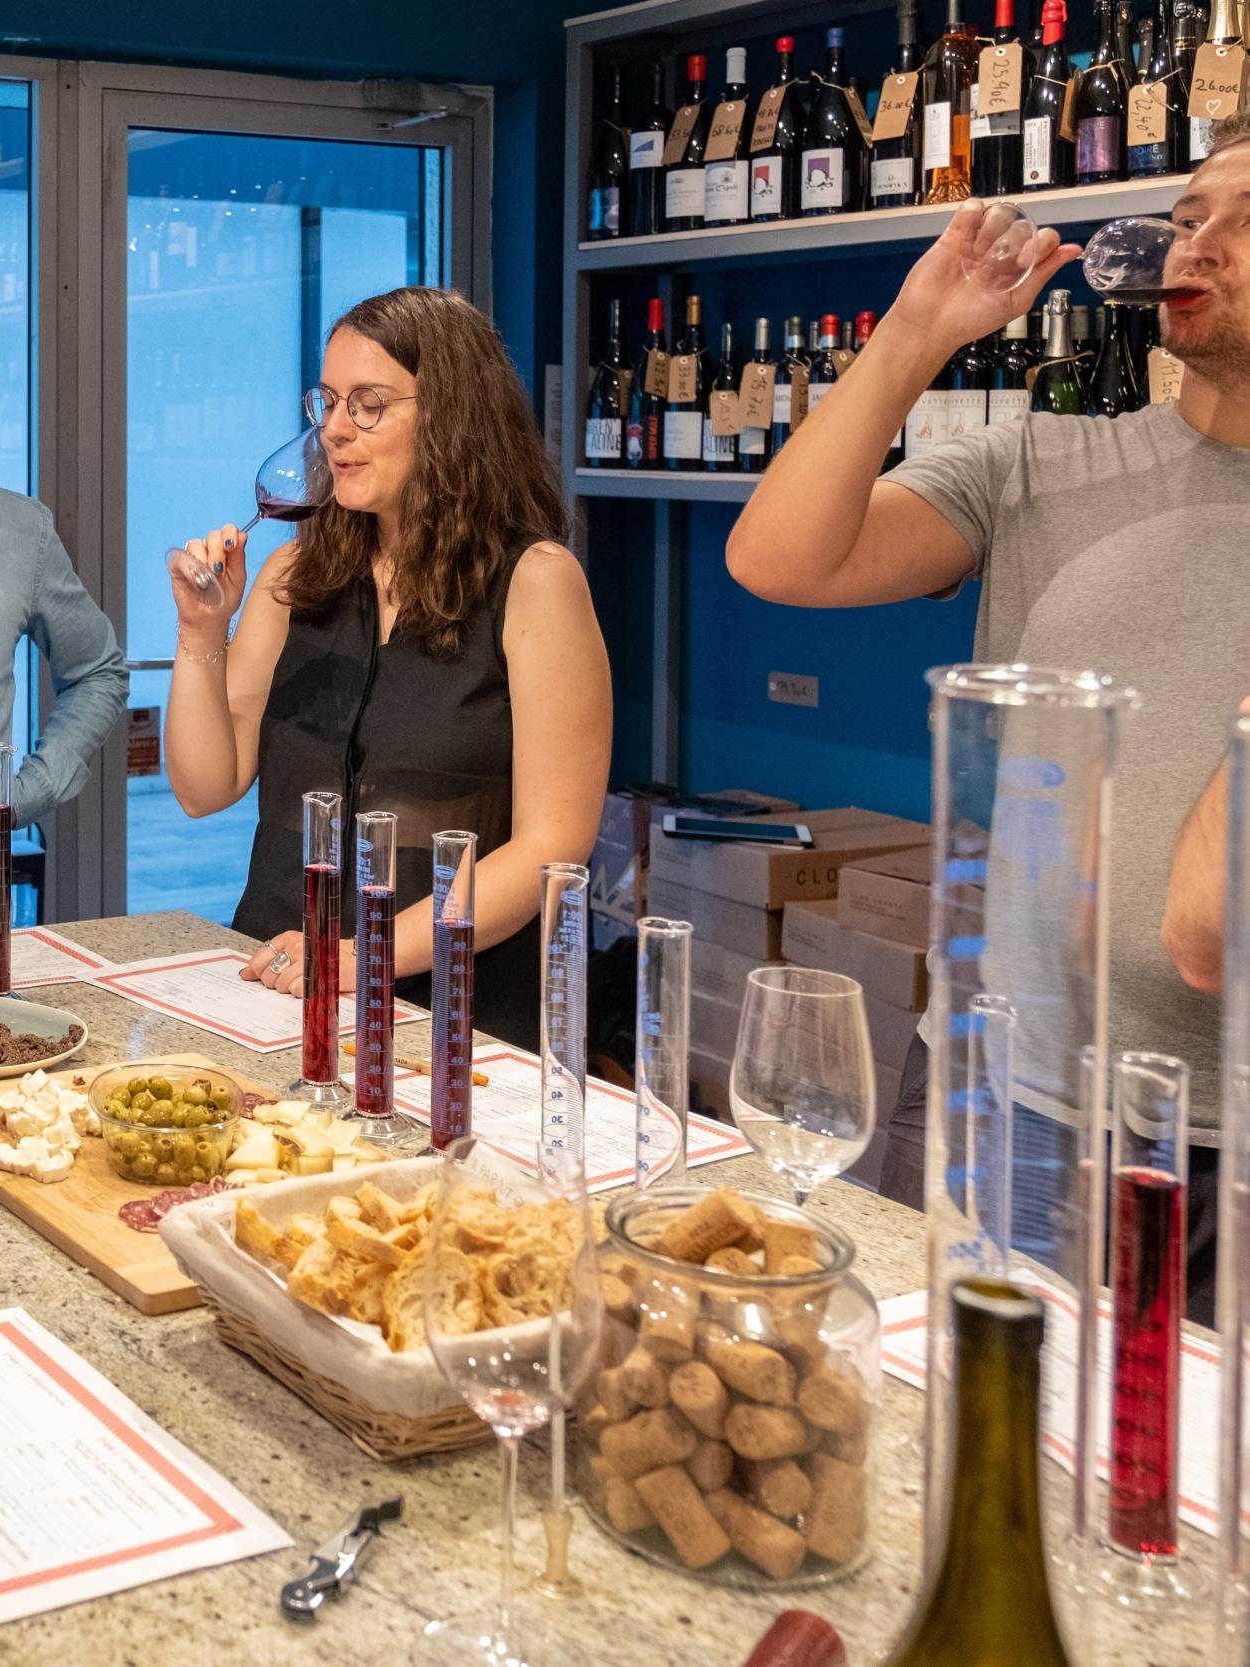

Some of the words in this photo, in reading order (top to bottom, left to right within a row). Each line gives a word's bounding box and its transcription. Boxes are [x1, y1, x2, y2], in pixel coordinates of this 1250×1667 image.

[989, 59, 1010, 107] 25.40€
[1195, 78, 1240, 94] 26.00€
[796, 867, 838, 886] CLO
